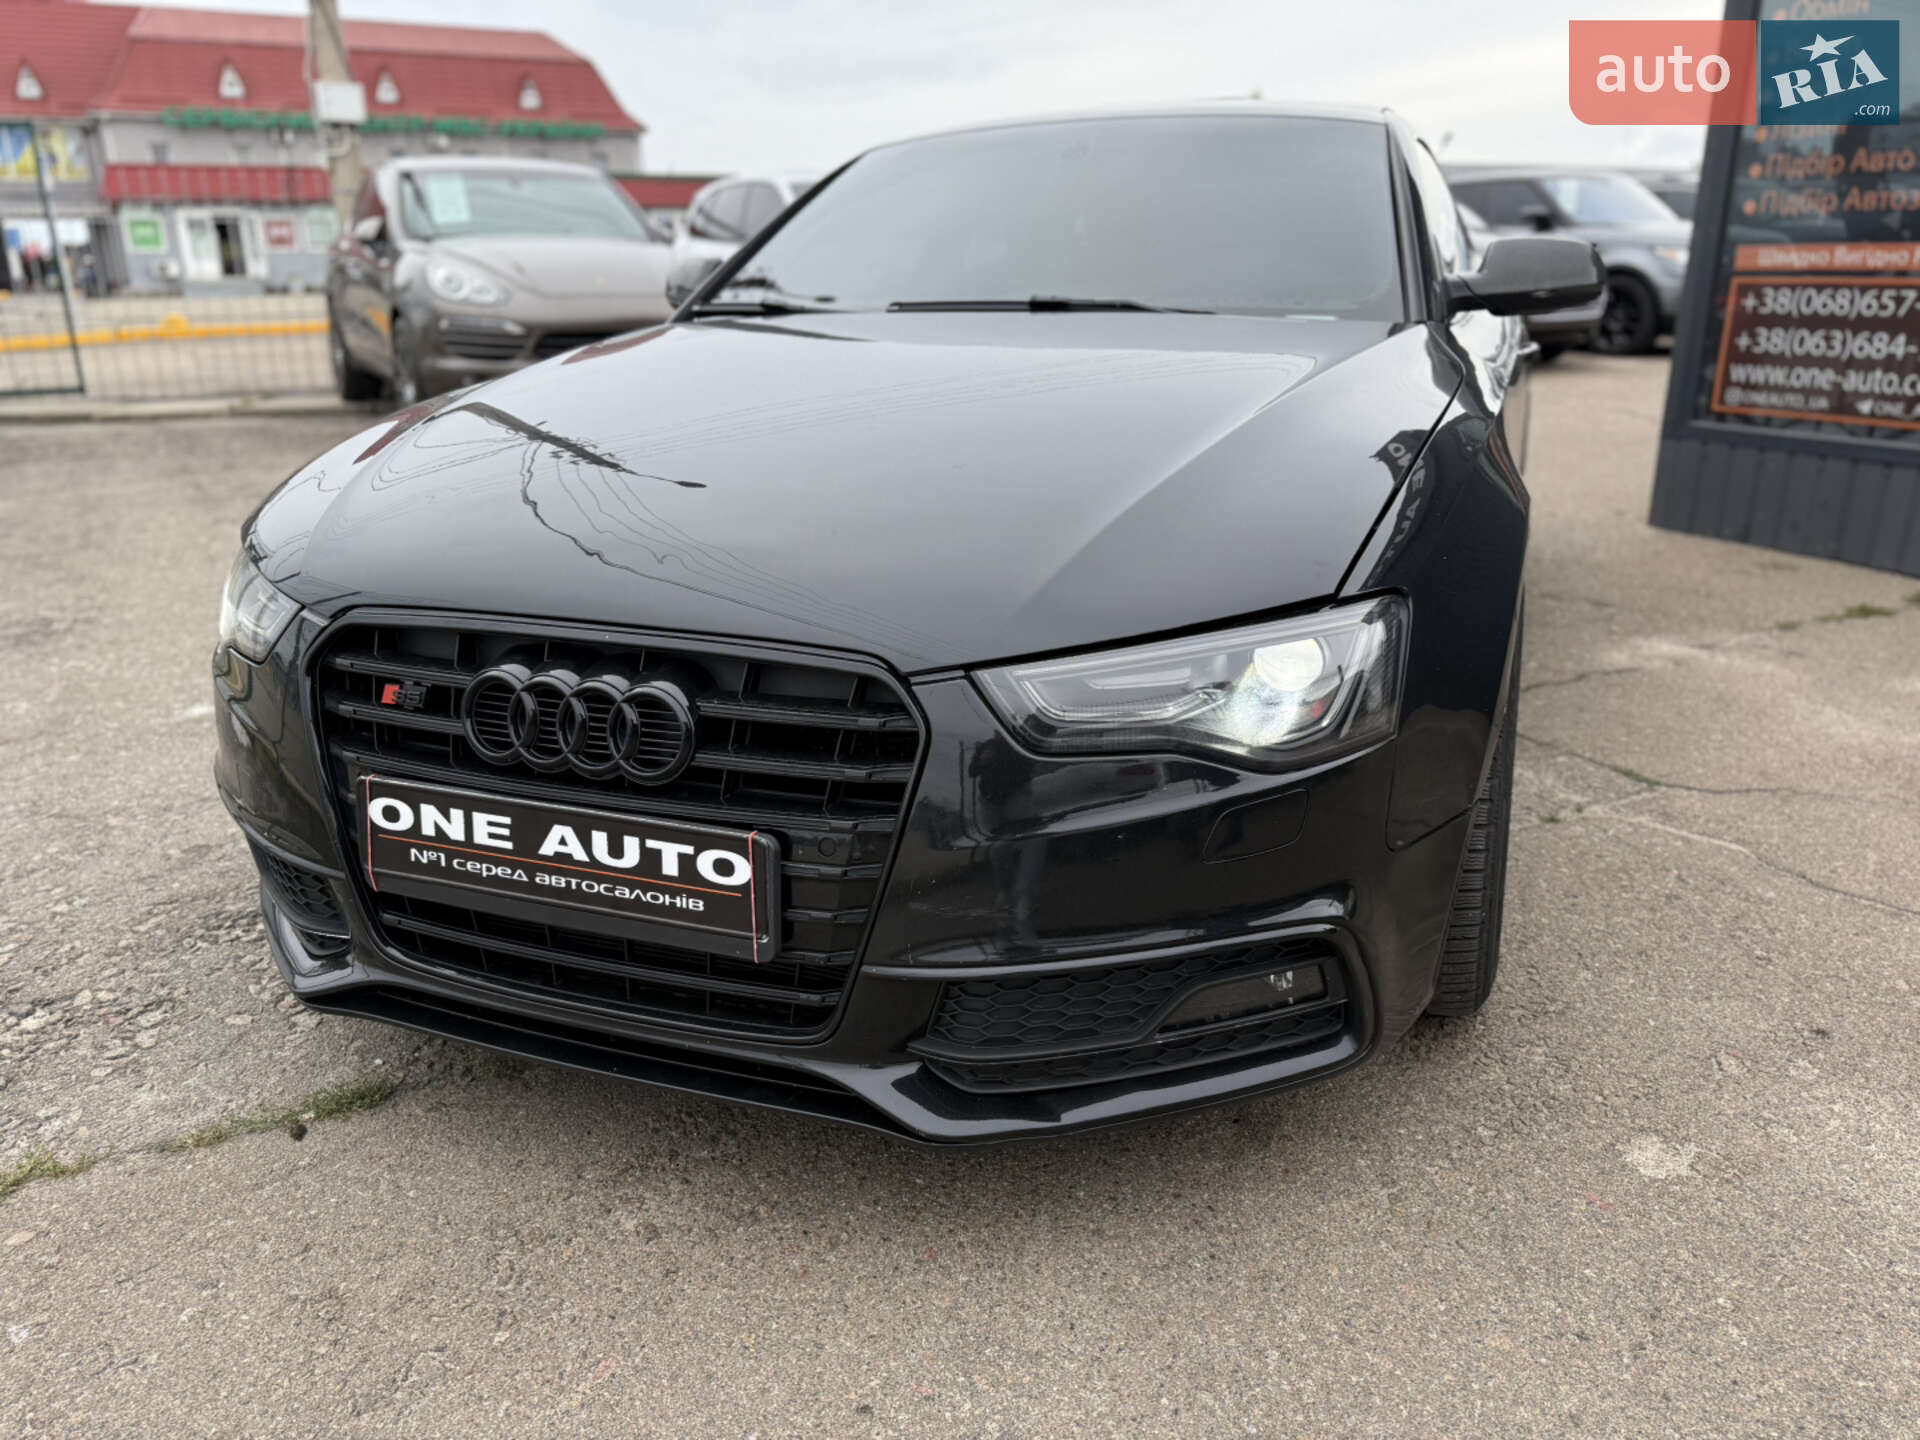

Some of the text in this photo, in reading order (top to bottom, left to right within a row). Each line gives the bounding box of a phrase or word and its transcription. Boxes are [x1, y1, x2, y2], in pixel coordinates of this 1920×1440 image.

[1850, 147, 1917, 175] Авто
[369, 797, 752, 886] ONE AUTO
[452, 858, 529, 882] серед
[535, 872, 705, 912] автосалонів
